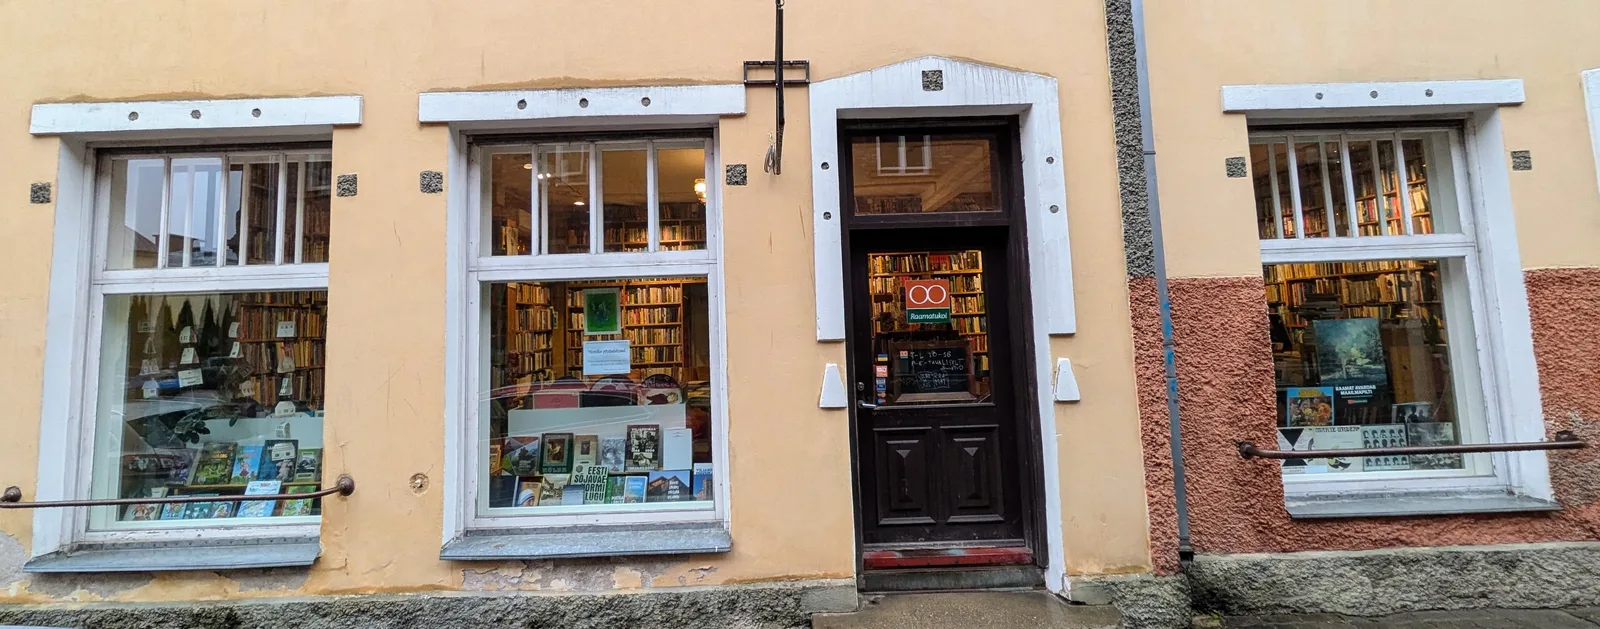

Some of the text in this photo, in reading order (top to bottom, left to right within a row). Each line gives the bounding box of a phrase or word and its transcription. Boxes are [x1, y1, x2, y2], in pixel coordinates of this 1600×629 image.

[910, 312, 947, 320] Raamatukoi
[588, 466, 607, 475] EESTI
[584, 483, 605, 492] ORMI
[585, 492, 604, 501] LUGU
